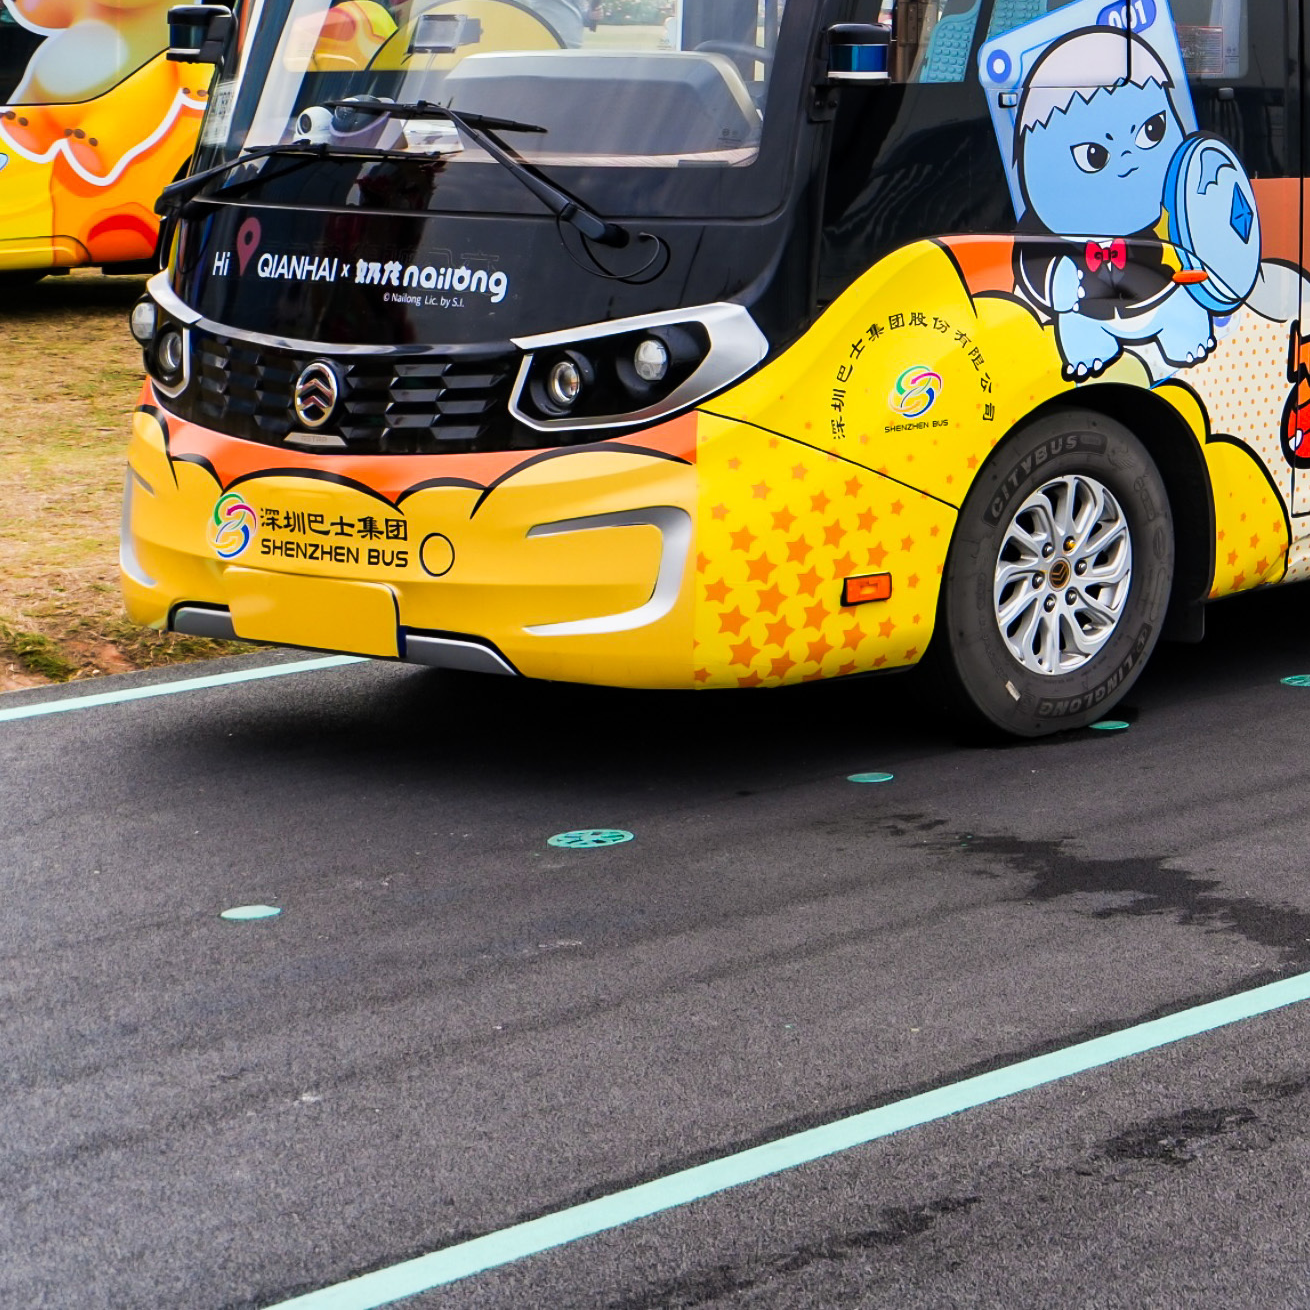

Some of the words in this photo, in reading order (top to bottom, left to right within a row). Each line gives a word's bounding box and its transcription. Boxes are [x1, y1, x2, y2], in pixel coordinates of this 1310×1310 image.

[1108, 0, 1147, 29] 001
[212, 252, 231, 276] Hi
[257, 252, 338, 282] QIANHAI
[402, 264, 508, 303] nailong
[391, 292, 421, 306] Nailong
[424, 295, 438, 305] Lic.
[440, 296, 450, 308] by
[831, 312, 996, 440] 深圳巴士集团股份有限公司
[884, 421, 929, 433] SHENZHEN
[932, 419, 949, 429] BUS
[989, 434, 1079, 520] CITYBUS
[260, 508, 408, 541] 深圳巴士集团
[260, 538, 360, 564] SHENZHEN
[367, 548, 409, 568] BUS
